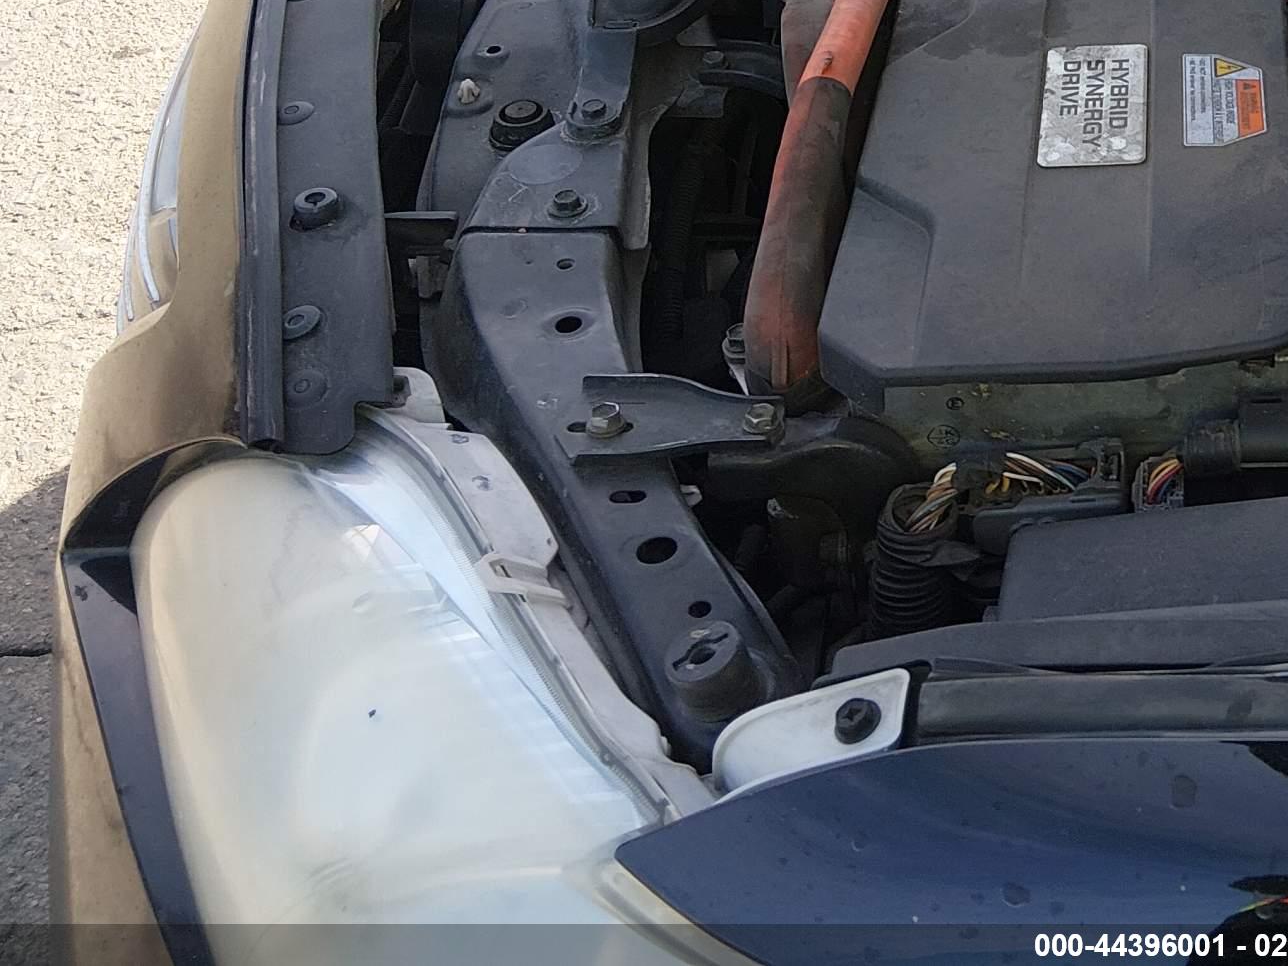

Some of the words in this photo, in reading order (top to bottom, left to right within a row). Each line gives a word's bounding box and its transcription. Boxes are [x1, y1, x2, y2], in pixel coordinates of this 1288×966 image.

[1059, 60, 1082, 117] DRIVE
[1082, 59, 1106, 148] SYNERGY
[1108, 58, 1130, 129] HYBRID
